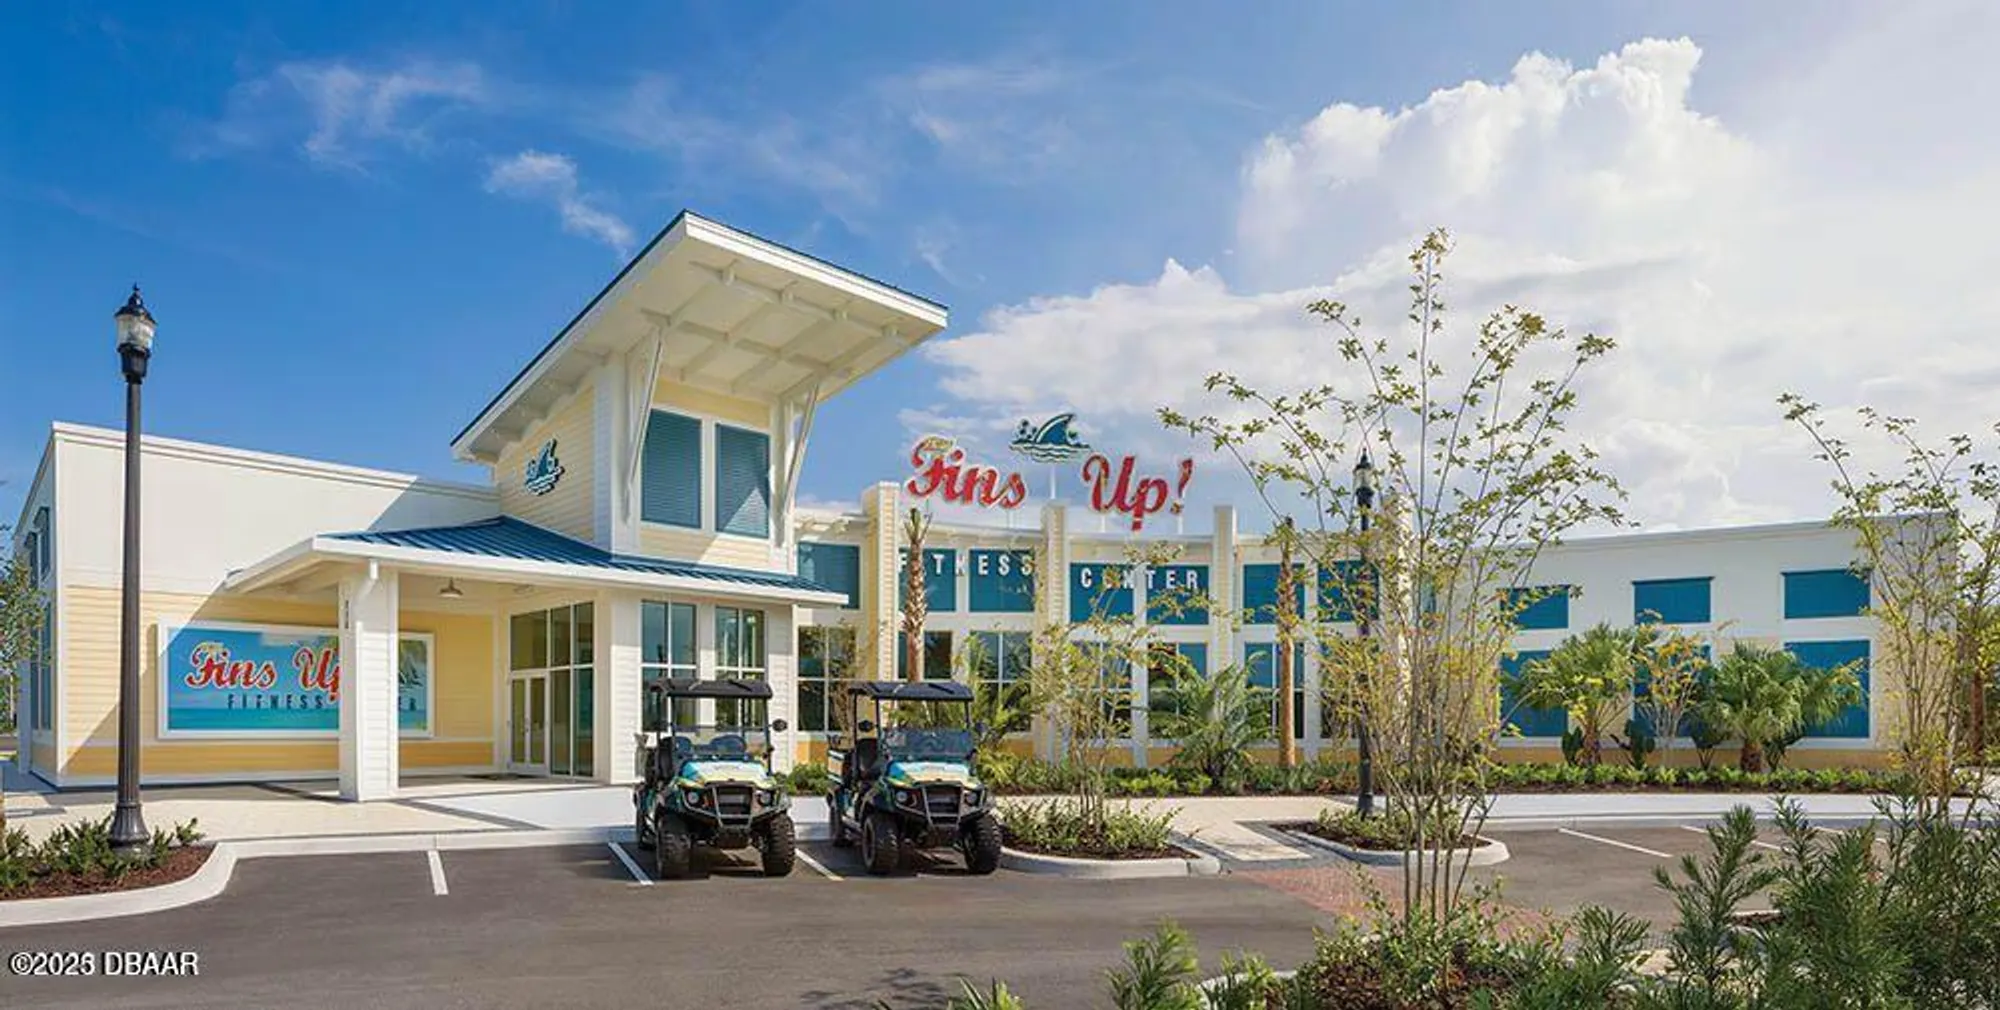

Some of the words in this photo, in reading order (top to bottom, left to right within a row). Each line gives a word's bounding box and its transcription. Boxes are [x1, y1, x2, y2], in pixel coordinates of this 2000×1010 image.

[906, 436, 1027, 509] Fins
[1082, 453, 1193, 531] Up!
[897, 553, 1034, 576] FTNESS
[185, 641, 277, 690] Fins
[228, 694, 323, 709] FITNESS
